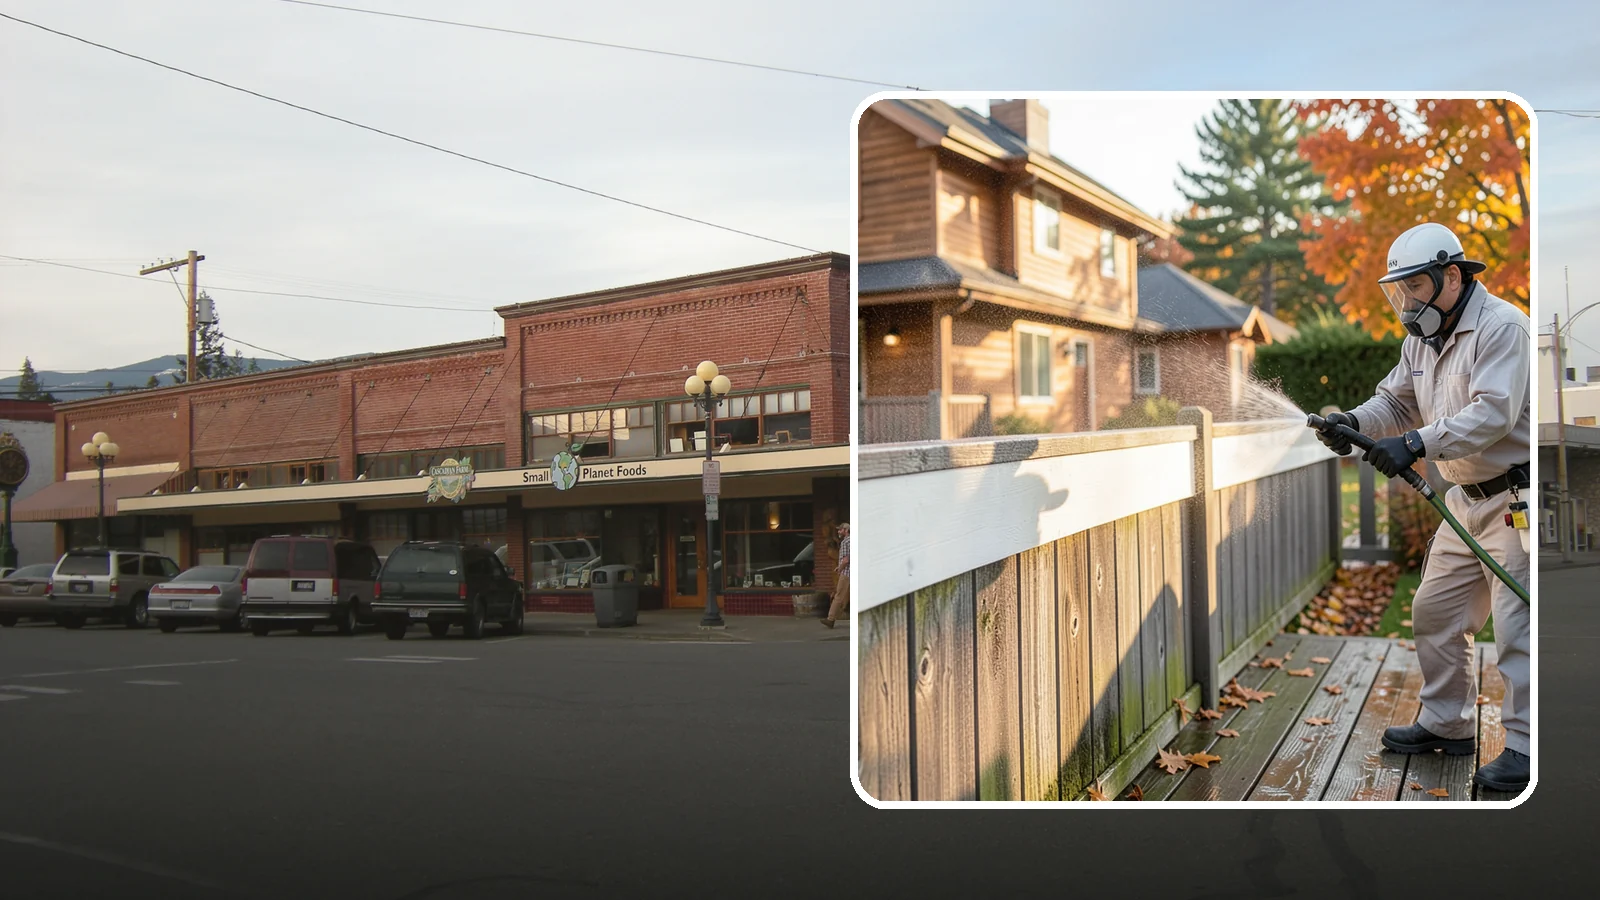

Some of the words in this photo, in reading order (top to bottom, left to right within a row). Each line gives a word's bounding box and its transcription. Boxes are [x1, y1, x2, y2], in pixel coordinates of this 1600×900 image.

[523, 471, 549, 483] Small
[583, 467, 614, 479] Planet
[617, 464, 647, 476] Foods
